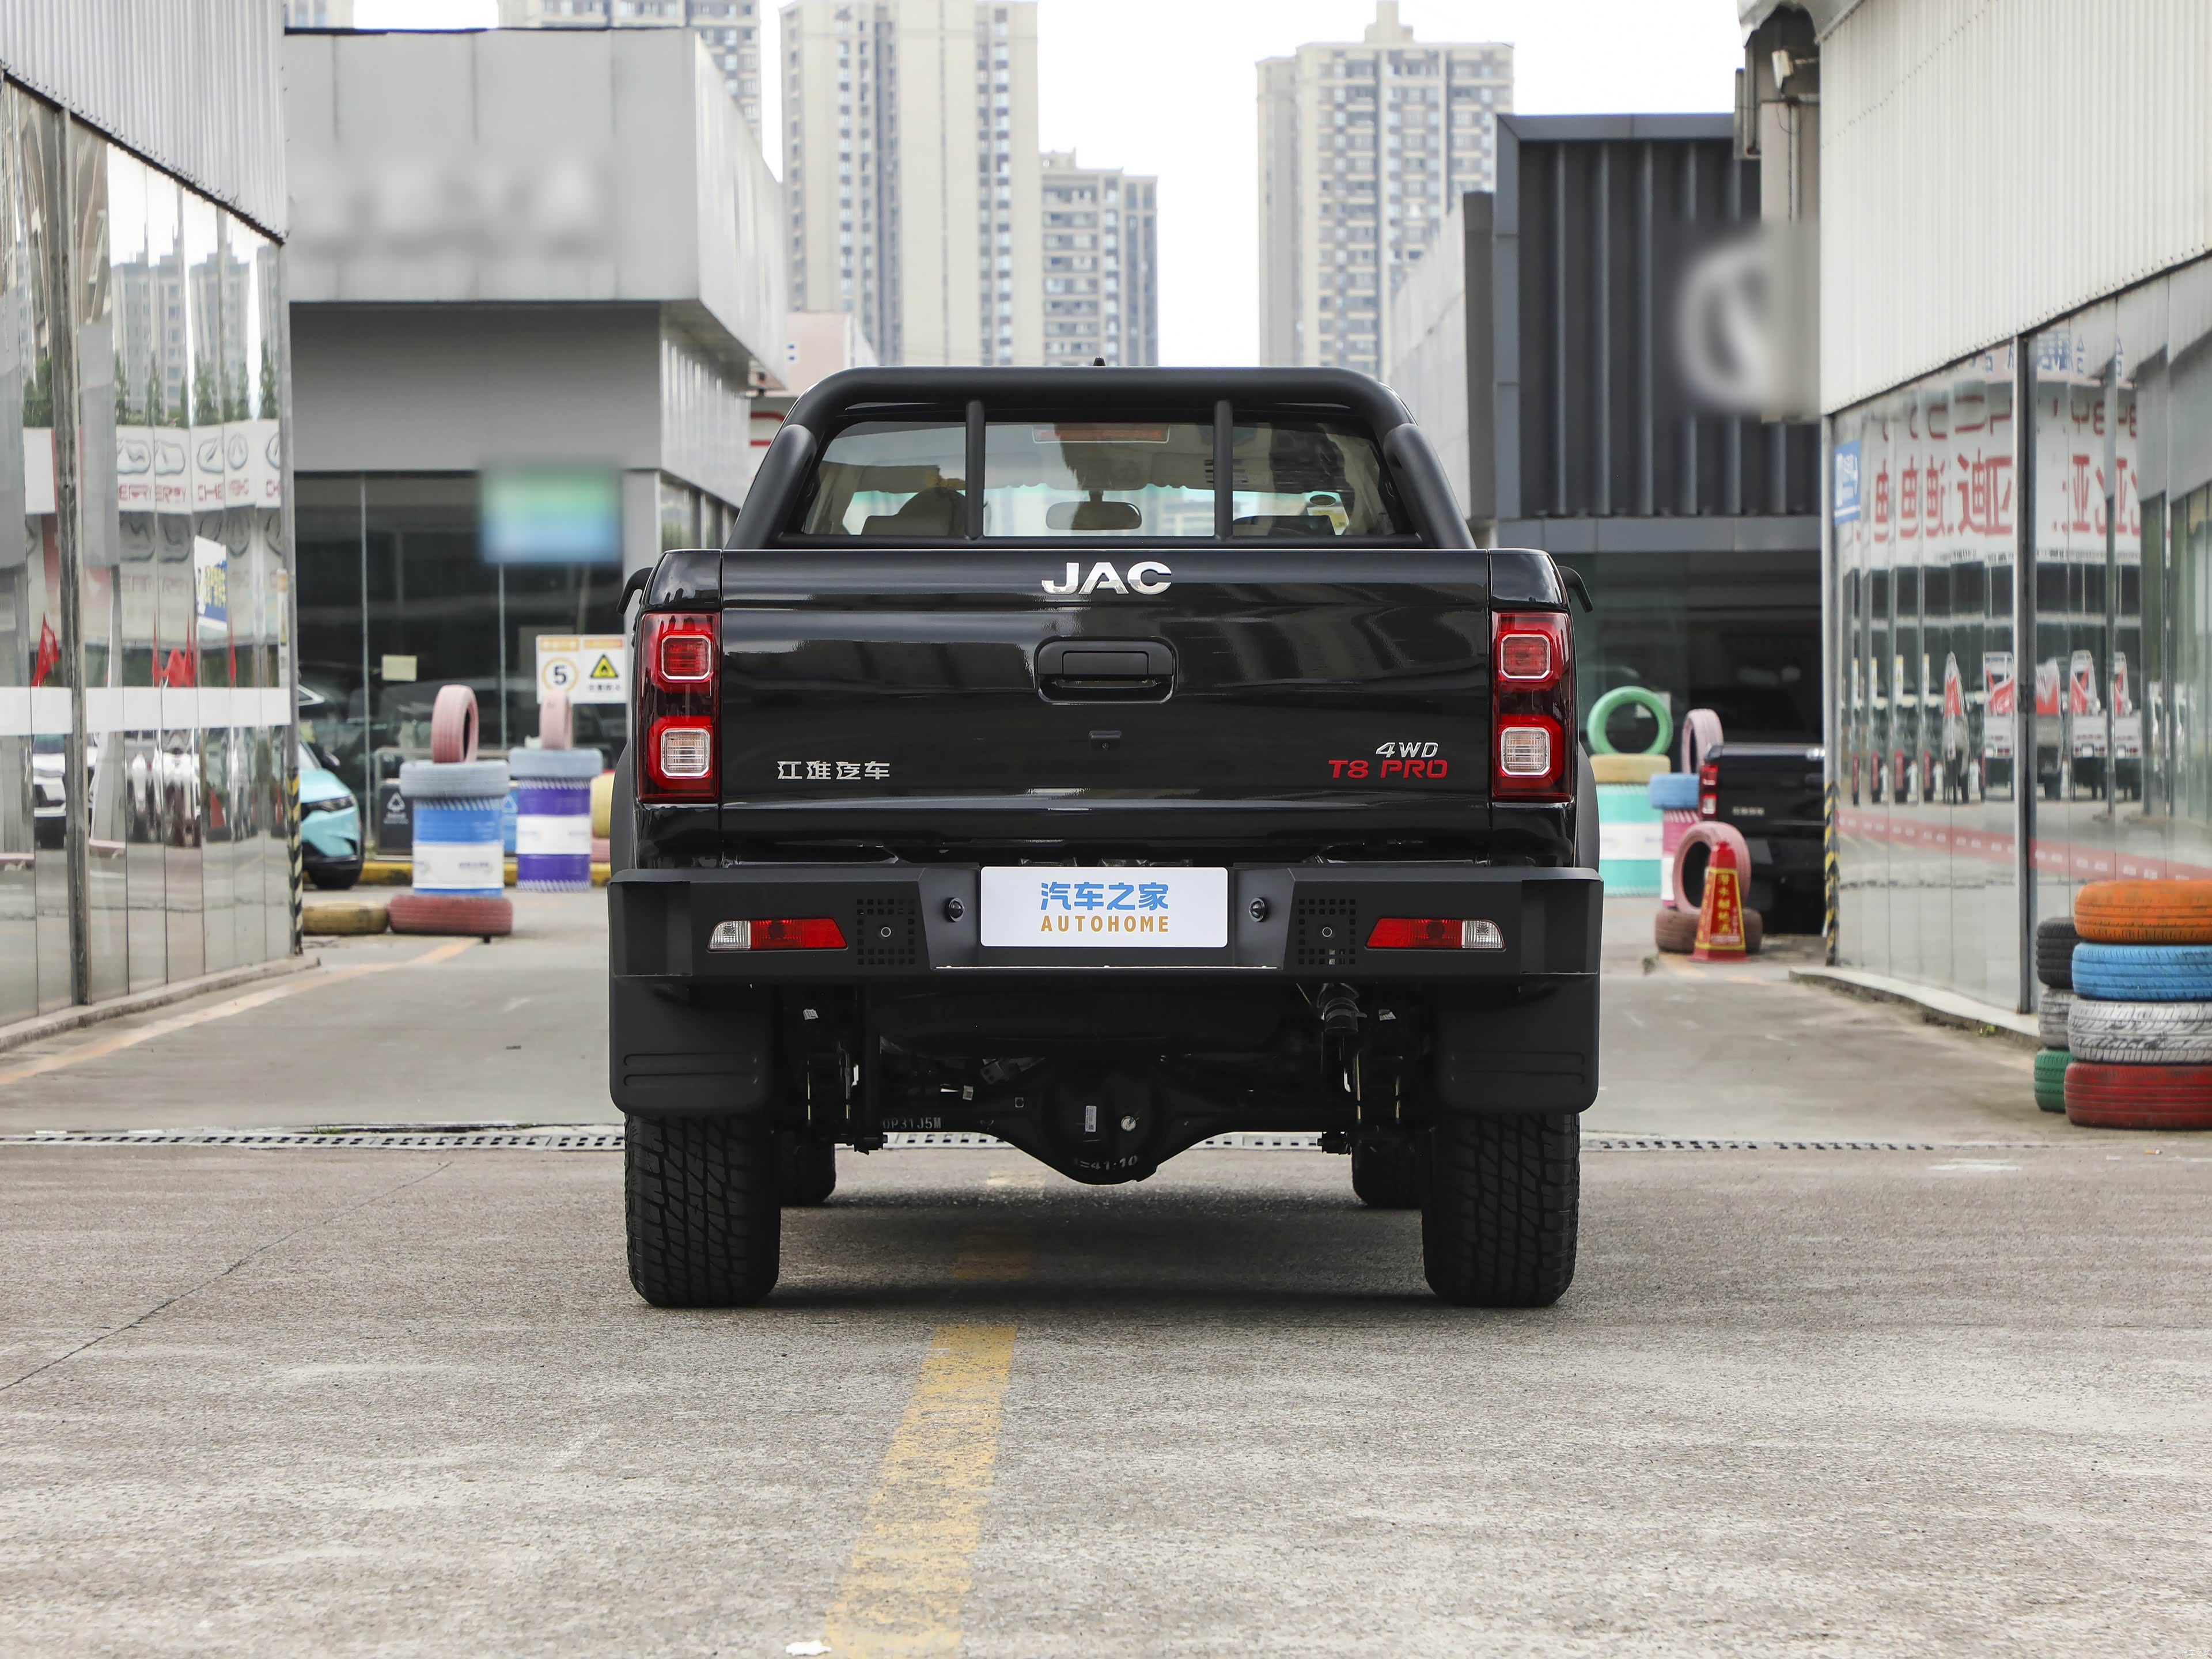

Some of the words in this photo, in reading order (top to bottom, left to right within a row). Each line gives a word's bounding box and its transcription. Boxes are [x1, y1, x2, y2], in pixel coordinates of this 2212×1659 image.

[1041, 561, 1172, 595] JAC
[554, 665, 567, 685] 5
[1375, 742, 1439, 759] 4WD
[777, 760, 890, 780] 江淮汽车
[1328, 760, 1369, 779] T8
[1380, 760, 1448, 779] PRO
[1040, 881, 1169, 911] 汽车之家
[1040, 915, 1169, 933] AUTOHOME
